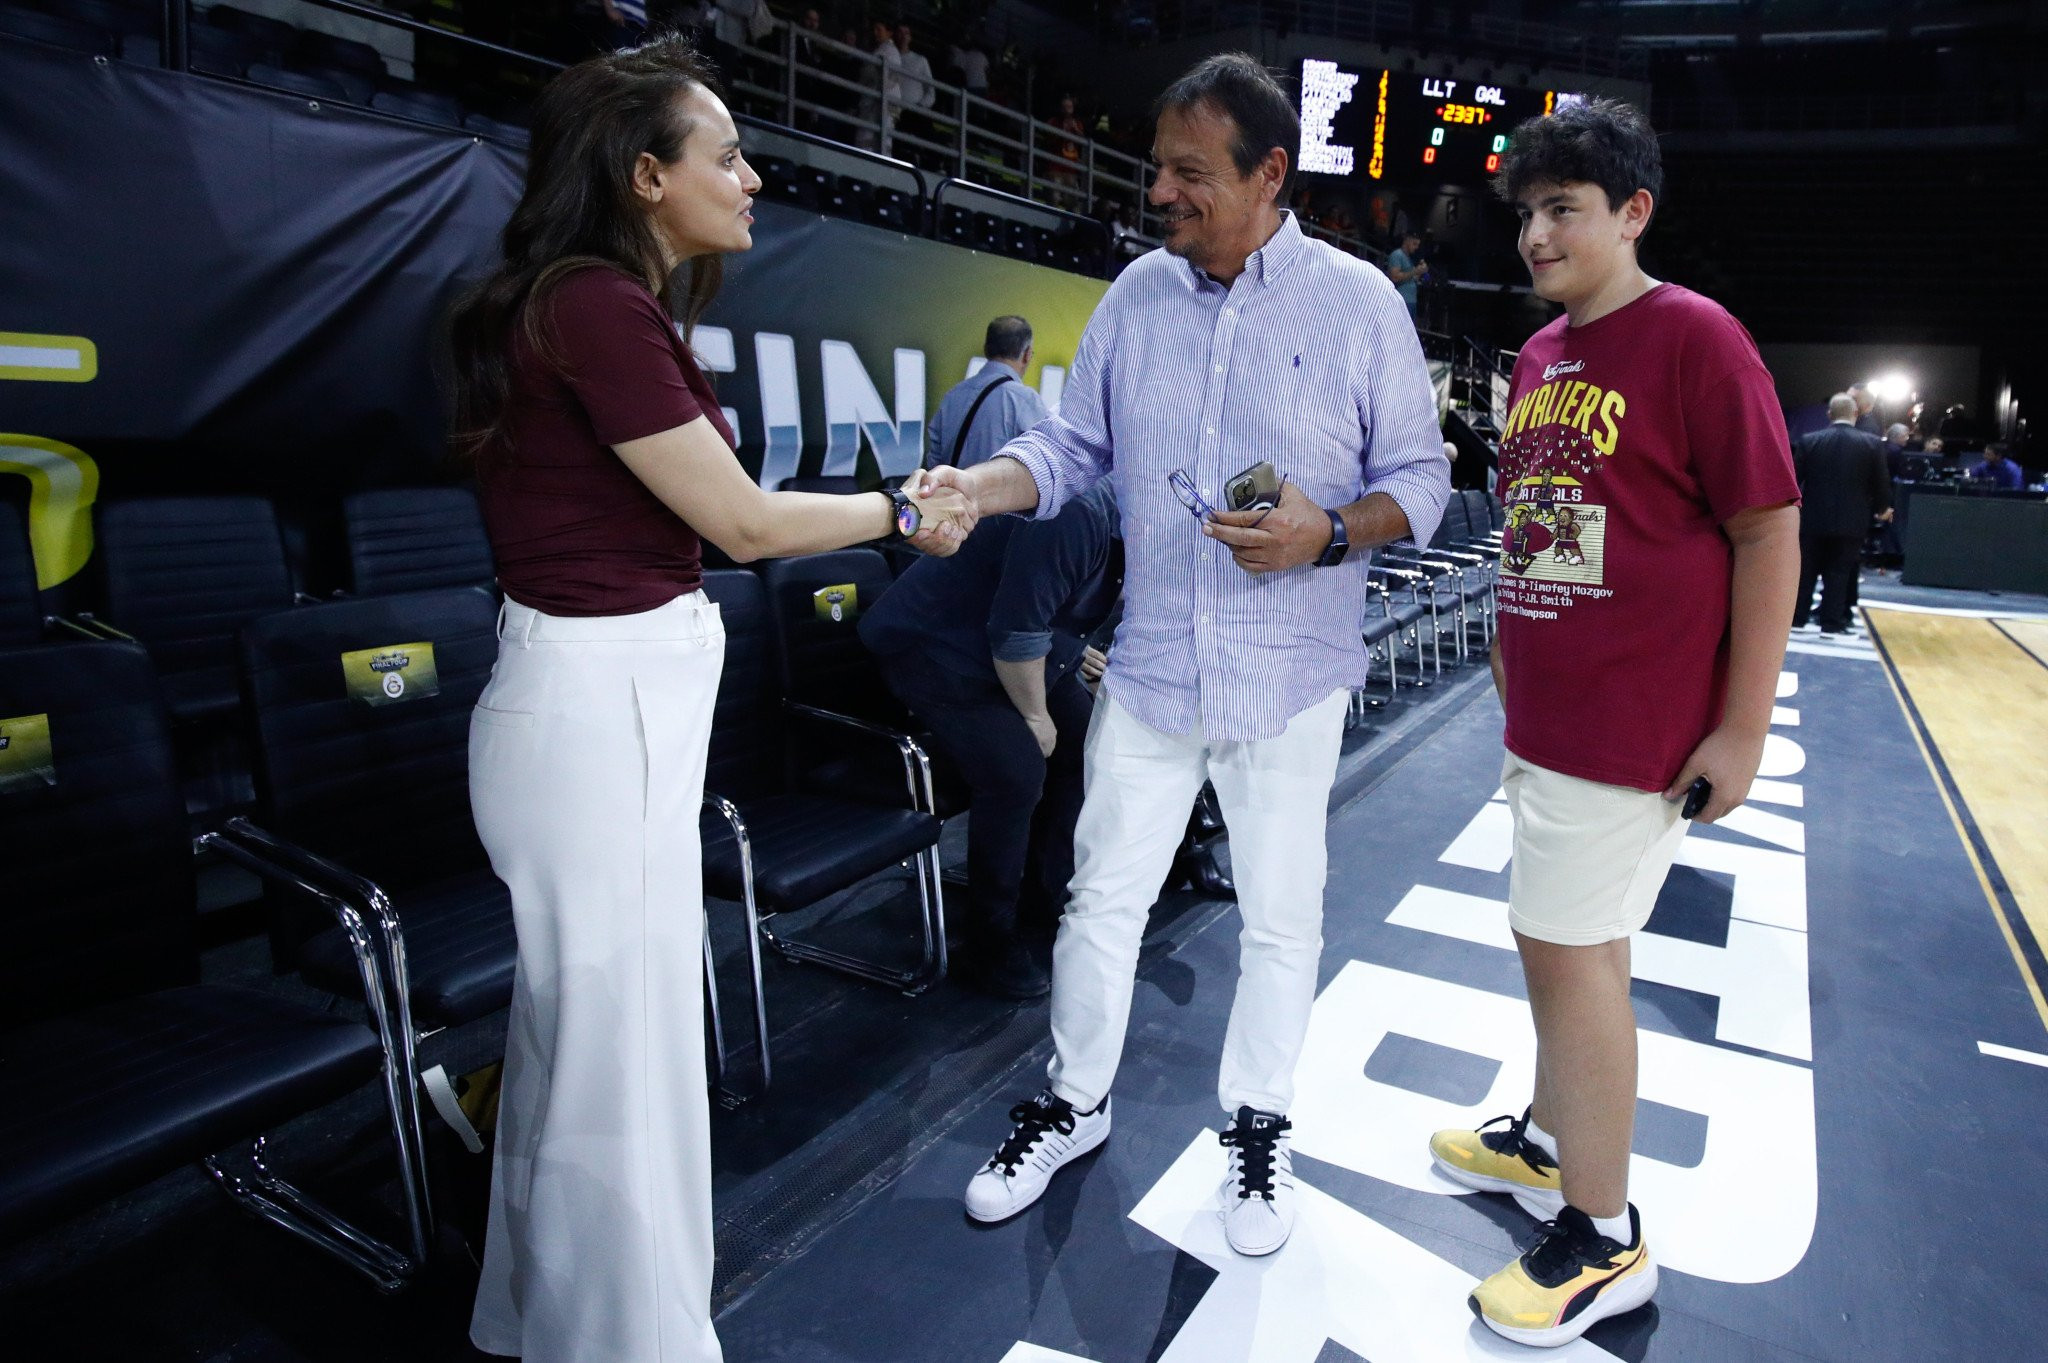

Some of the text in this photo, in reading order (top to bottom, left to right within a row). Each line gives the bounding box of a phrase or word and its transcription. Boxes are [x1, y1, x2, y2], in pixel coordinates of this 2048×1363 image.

[1423, 78, 1505, 106] LLT GAL
[1431, 127, 1444, 146] 0
[1493, 135, 1505, 153] 0
[1424, 147, 1436, 163] 0
[1486, 154, 1498, 171] 0
[1500, 380, 1627, 456] AVALIERS
[1572, 585, 1614, 599] Mozgov
[1541, 595, 1573, 607] Smith
[1519, 606, 1558, 620] Thompson
